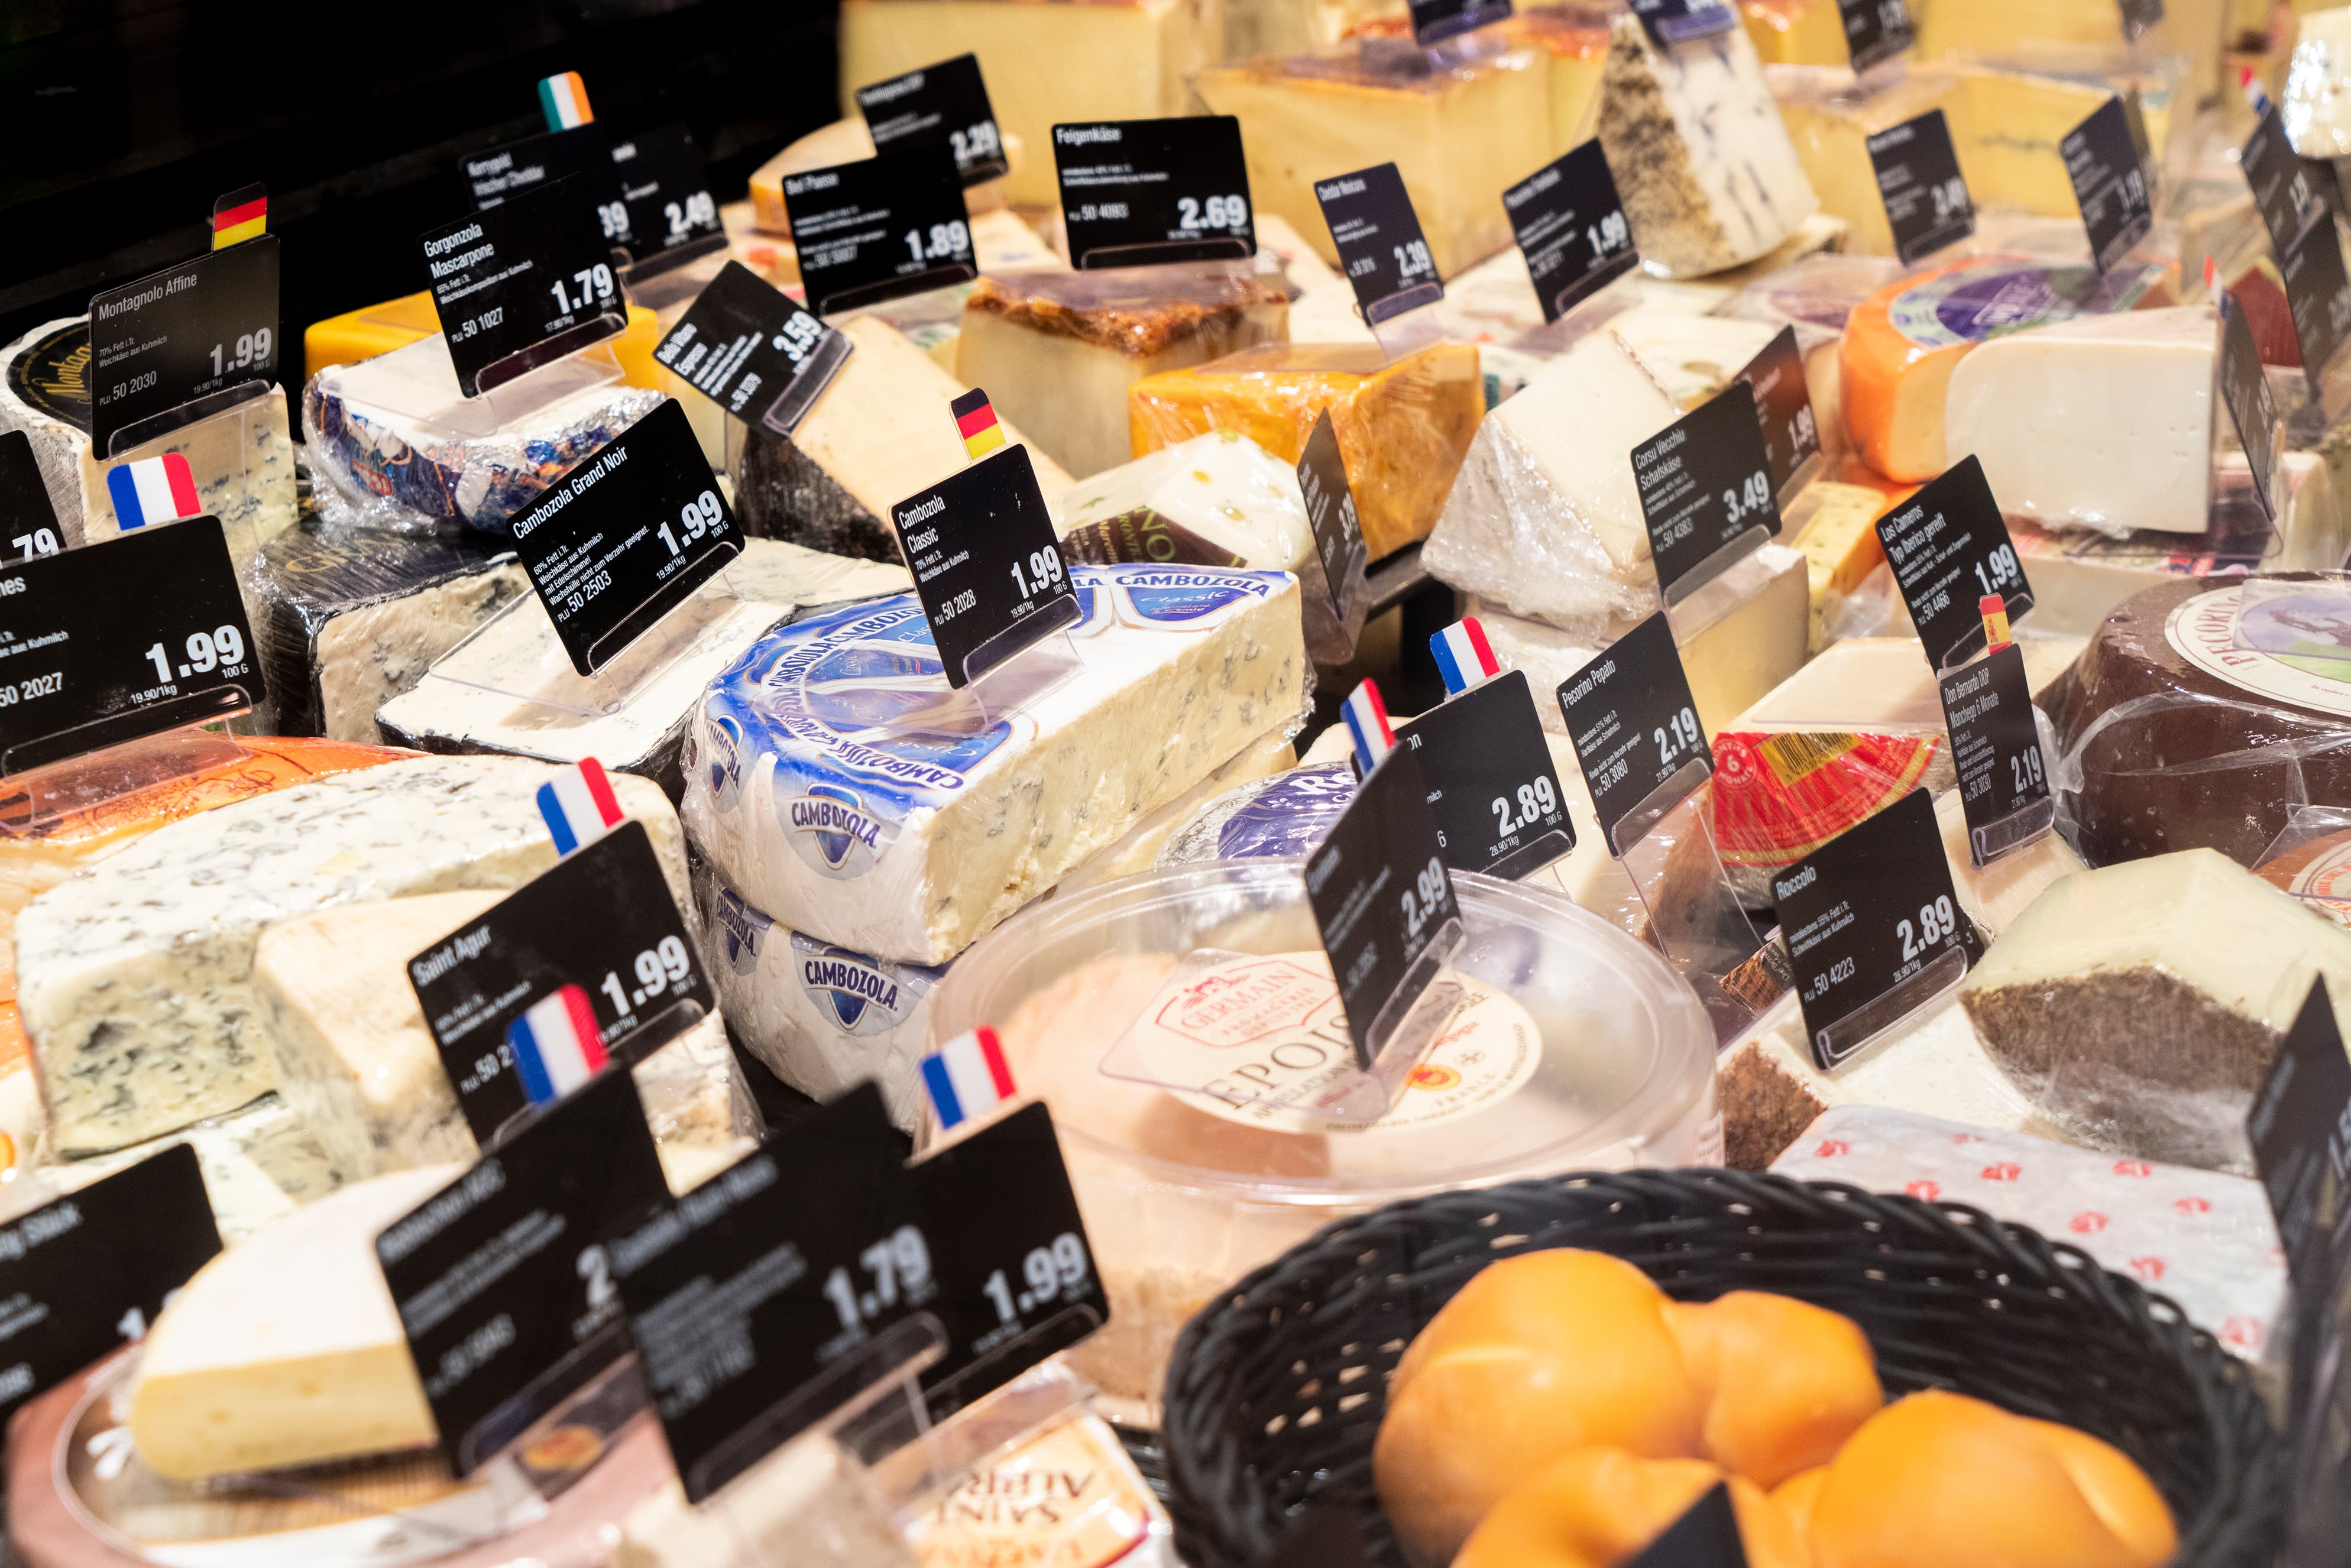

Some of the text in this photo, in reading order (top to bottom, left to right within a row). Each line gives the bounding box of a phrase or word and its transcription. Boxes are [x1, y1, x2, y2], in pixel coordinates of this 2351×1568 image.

[1056, 125, 1122, 146] Feigenkäse
[597, 200, 630, 238] 39
[663, 190, 716, 235] 2.49
[1177, 194, 1247, 229] 2.69
[423, 222, 484, 258] Gorgonzola
[904, 219, 969, 261] 1.89
[1587, 209, 1628, 255] 1.99
[430, 242, 495, 279] Mascarpone
[1394, 238, 1433, 277] 2.39
[99, 273, 197, 321] Montagnolo Affine
[551, 263, 614, 315] 1.79
[452, 306, 504, 344] PLU 50 1027
[772, 310, 824, 362] 3.59
[99, 340, 125, 358] 70% Fett
[99, 335, 168, 368] Weichkäse aus Kuhmilch
[210, 327, 273, 377] 1.99
[99, 370, 158, 406] PLU 50 2030
[193, 377, 224, 395] 19.90/1kg
[1787, 403, 1815, 451] 1.99
[1635, 427, 1686, 471] Corsu Vecchiu
[512, 444, 629, 540] Cambozola Grand Noir
[1640, 455, 1683, 491] Schafskäse
[898, 494, 946, 530] Cambozola
[1722, 470, 1770, 524] 3.49
[656, 490, 724, 558] 1.99
[710, 520, 730, 539] 100 G
[906, 526, 940, 555] Classic
[1663, 517, 1694, 548] 50 4383
[1880, 504, 1925, 543] Los Cameros
[1888, 511, 1947, 565] Typ Iberico gereift
[533, 544, 569, 575] 60% Fett i.Tr.
[538, 532, 604, 586] Weichkäse aus Kuhmilch
[545, 555, 592, 597] mit Edelschimmel
[548, 524, 650, 607] Wachshülle nicht zum Verzehr geeignet.
[655, 553, 687, 581] 19.90/1kg
[915, 555, 936, 572] 70% Fett
[919, 549, 970, 584] Weichkäse aus Kuhmilch
[1011, 545, 1063, 600] 1.99
[1974, 543, 2018, 594] 1.99
[557, 570, 613, 624] PLU 50 2503
[1053, 582, 1064, 595] 100
[1116, 574, 1271, 598] CAMBOZOLA
[1922, 589, 1951, 621] 50 4466
[828, 607, 924, 646] CAMBOZO
[934, 588, 977, 627] PLU 50 2028
[1010, 599, 1035, 619] 19.90/1kg
[10, 630, 70, 655] aus Kuhmilch
[898, 624, 930, 643] Clas
[145, 624, 245, 684] 1.99
[221, 663, 250, 679] 100 G
[21, 671, 63, 700] 2027
[130, 683, 178, 705] 19.90/1kg
[1561, 658, 1617, 710] Pecorino Pepato
[1945, 666, 1990, 705] Don Bernardo DOP
[1949, 690, 1999, 730] Manchego 6 Monate
[1577, 713, 1612, 747] mindestens Fett
[1581, 738, 1597, 758] Hartkäse
[1653, 707, 1701, 766] 2.19
[831, 739, 965, 790] CAMBOZOLA
[1589, 744, 1628, 781] Rinde nicht Verzehr
[1599, 758, 1628, 792] 50 3080
[1727, 754, 1740, 773] 6
[2010, 745, 2042, 794] 2.19
[1970, 772, 1992, 799] 50 3030
[791, 801, 878, 850] CAMBOZOLA
[1492, 775, 1557, 838] 2.89
[1544, 813, 1557, 828] 100
[1489, 835, 1520, 858] 28.90/1kg
[1401, 856, 1447, 938] 2.99
[1775, 864, 1817, 902] Roccolo
[717, 897, 755, 952] CAMBOZOLA
[1788, 905, 1841, 944] mindestens 55% Fett
[1792, 911, 1855, 958] Schnittkäse aus Kuhmilch
[1896, 893, 1955, 963] 2.89
[412, 923, 493, 987] Saint Agur
[1892, 959, 1922, 983] 28.90/1kg
[601, 935, 691, 1018] 1.99
[805, 959, 898, 1013] CAMBOZOLA
[1803, 956, 1856, 1004] PLU 50 4223
[1181, 973, 1297, 1029] GERMAIN
[475, 1056, 501, 1082] 50
[1203, 1014, 1353, 1110] EPOI
[822, 1224, 933, 1330] 1.79
[982, 1231, 1090, 1324] 1.99
